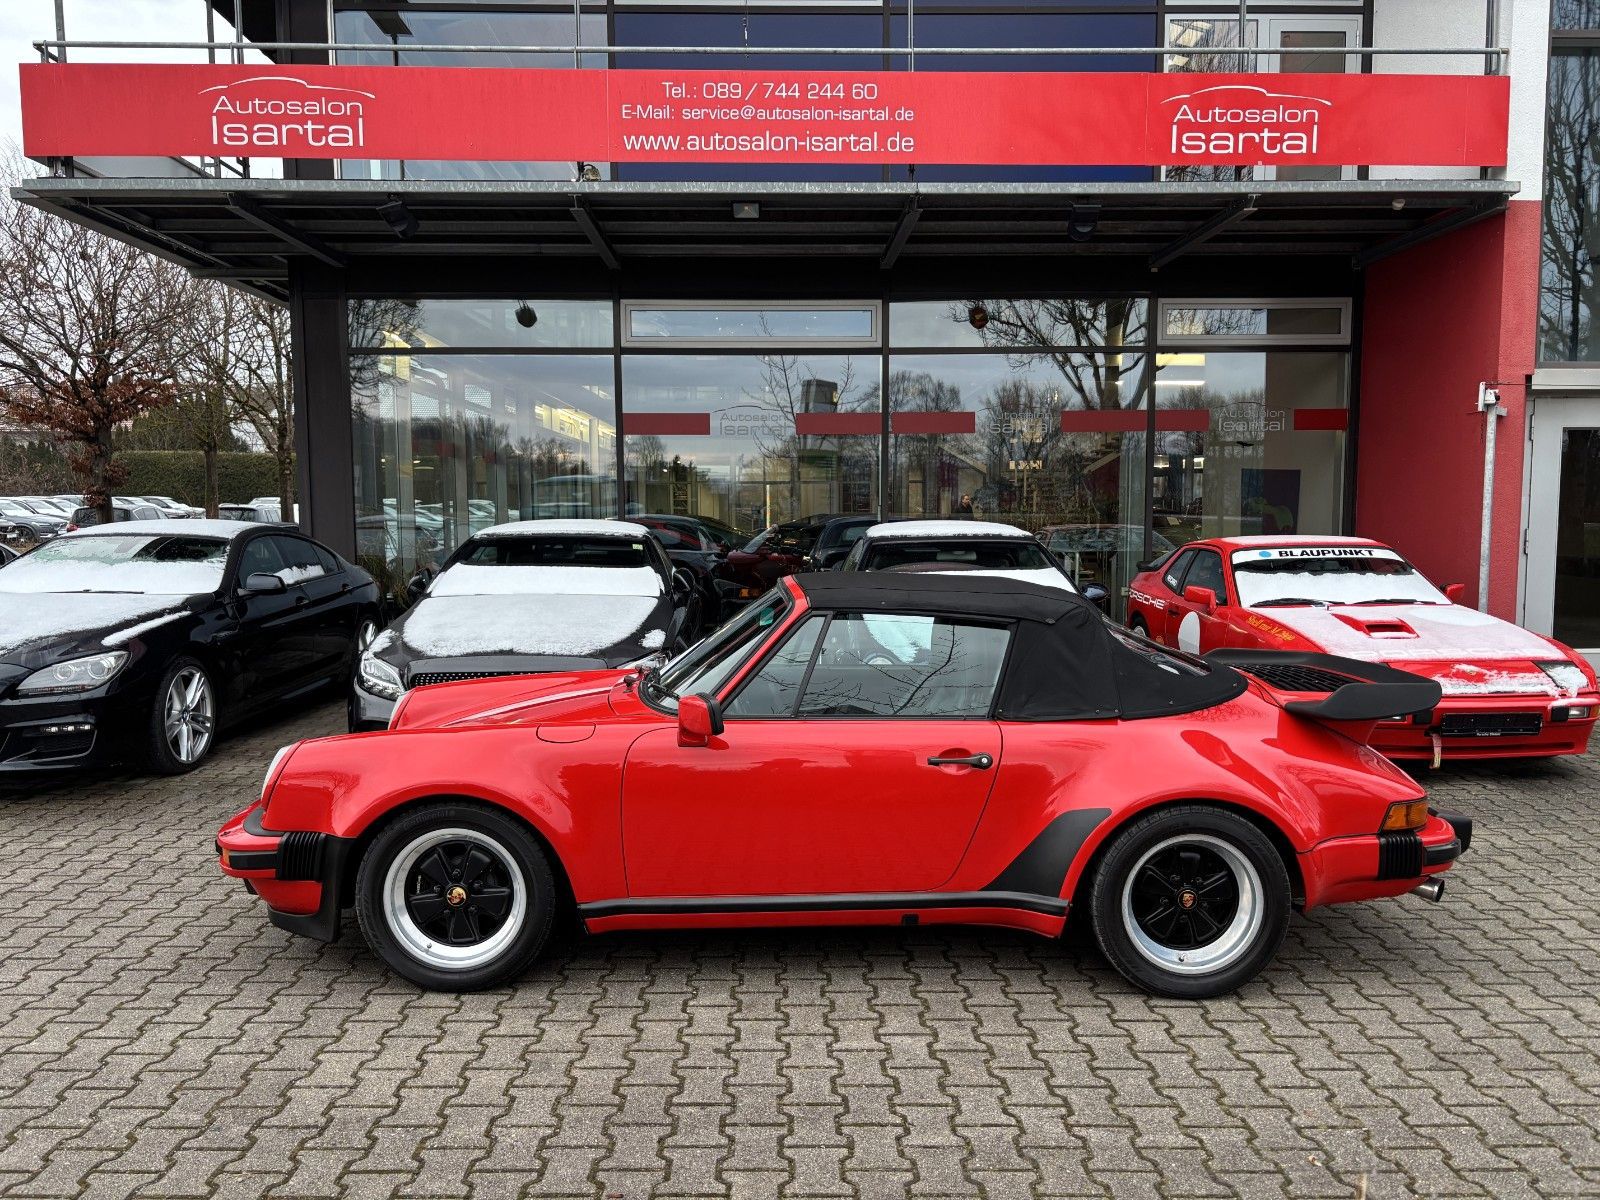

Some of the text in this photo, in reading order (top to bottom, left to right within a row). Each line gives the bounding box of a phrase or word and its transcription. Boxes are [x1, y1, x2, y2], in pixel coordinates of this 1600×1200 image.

[662, 82, 878, 101] Tel.: 089 / 744 244 60
[212, 95, 363, 116] Autosalon
[621, 104, 914, 121] E-Mail: service@autosalon-isartal.de
[1173, 104, 1319, 123] Autosalon
[211, 115, 364, 147] Isartal
[1171, 124, 1318, 154] Isartal
[623, 130, 915, 153] www.autosalon-isartal.de
[1278, 549, 1374, 557] BLAUPUNKT
